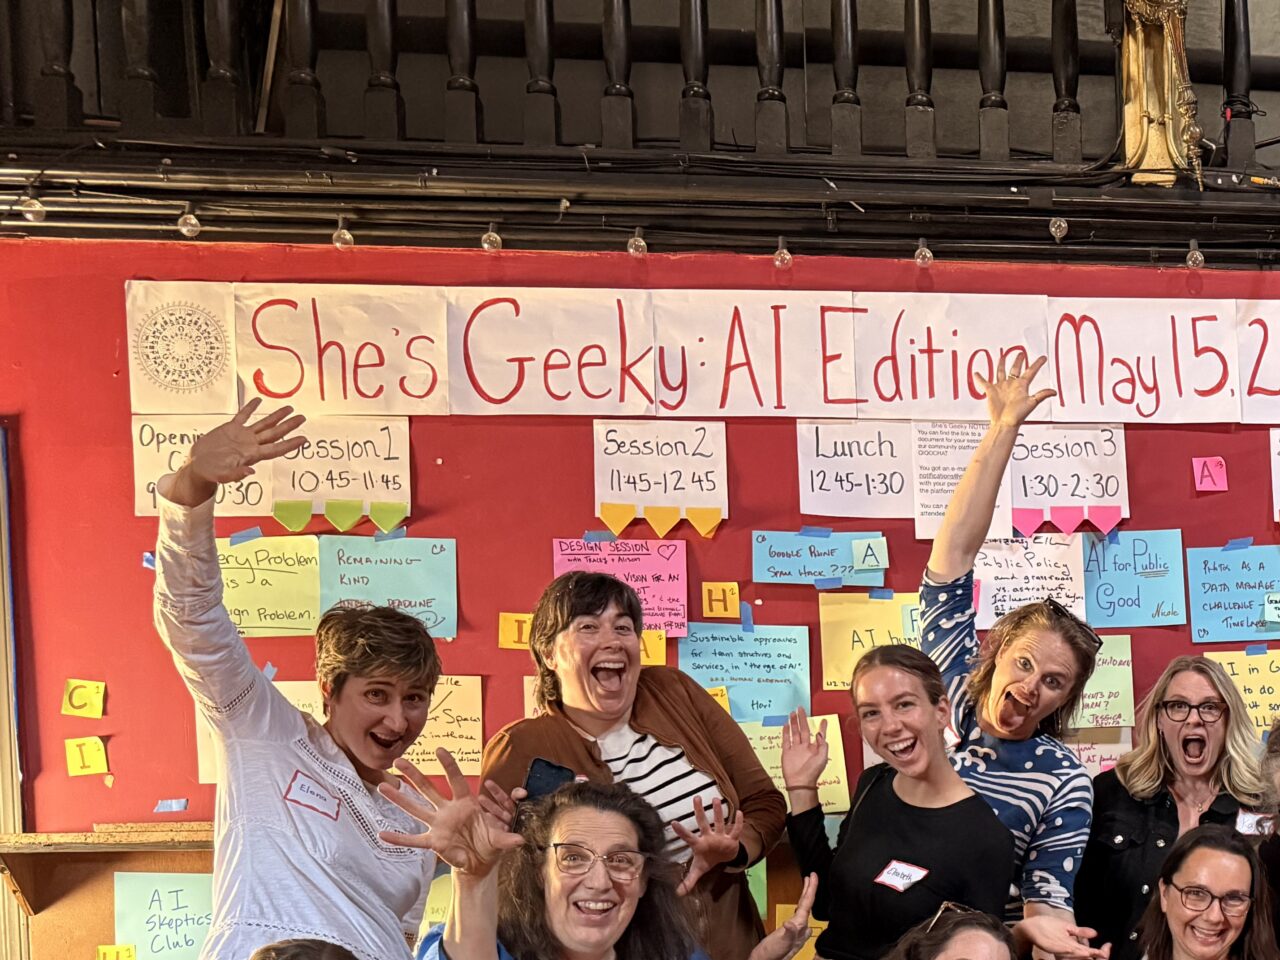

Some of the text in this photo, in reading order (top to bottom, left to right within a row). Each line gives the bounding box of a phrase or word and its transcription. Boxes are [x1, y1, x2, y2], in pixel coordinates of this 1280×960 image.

[252, 297, 438, 401] She's
[463, 297, 706, 410] Geeky:
[719, 303, 788, 410] AI
[1055, 312, 1158, 418] May
[604, 427, 714, 459] Session 2
[815, 426, 897, 459] Lunch
[1012, 428, 1117, 461] Session 3
[1021, 473, 1120, 499] 1:30-2:30
[1199, 460, 1217, 487] A
[254, 549, 318, 567] Problem
[559, 541, 651, 553] DESIGN SESSION
[862, 543, 880, 564] A
[1084, 538, 1170, 579] AI for Public
[1024, 551, 1071, 577] Policy
[260, 578, 273, 587] a
[707, 588, 728, 613] H
[1096, 582, 1141, 617] Good
[1248, 663, 1260, 675] in
[68, 684, 88, 710] C
[1243, 686, 1254, 694] to
[1259, 685, 1275, 695] do
[76, 743, 91, 770] I
[145, 912, 212, 933] Skeptics
[150, 933, 195, 954] Club
